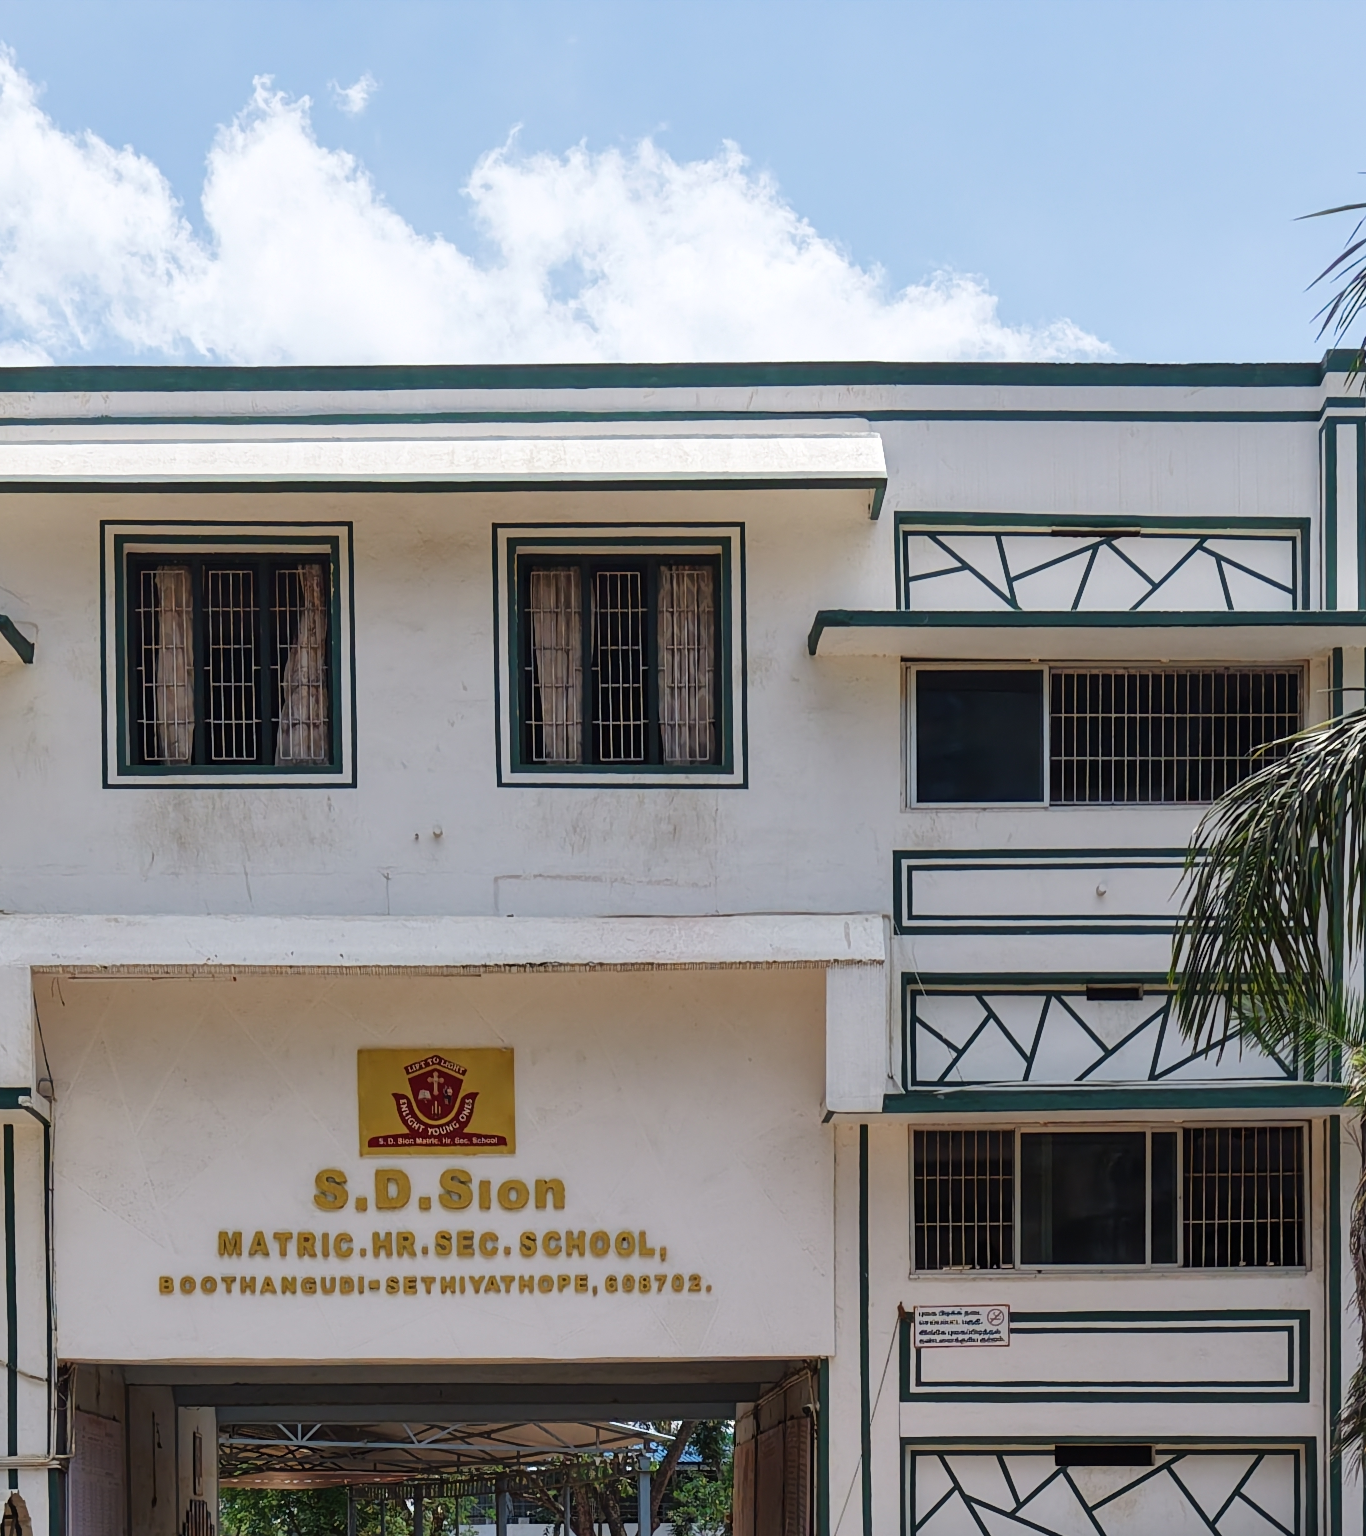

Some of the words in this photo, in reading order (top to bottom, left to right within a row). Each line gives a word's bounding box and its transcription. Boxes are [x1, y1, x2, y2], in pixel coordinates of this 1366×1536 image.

[408, 1061, 426, 1073] LIFT
[427, 1057, 439, 1065] TO
[440, 1059, 465, 1075] LIGHT
[399, 1098, 425, 1133] ENLIGHT
[427, 1121, 460, 1136] YOUNG
[458, 1098, 473, 1123] ONES
[472, 1137, 498, 1145] School
[313, 1168, 567, 1213] S.D.Sion
